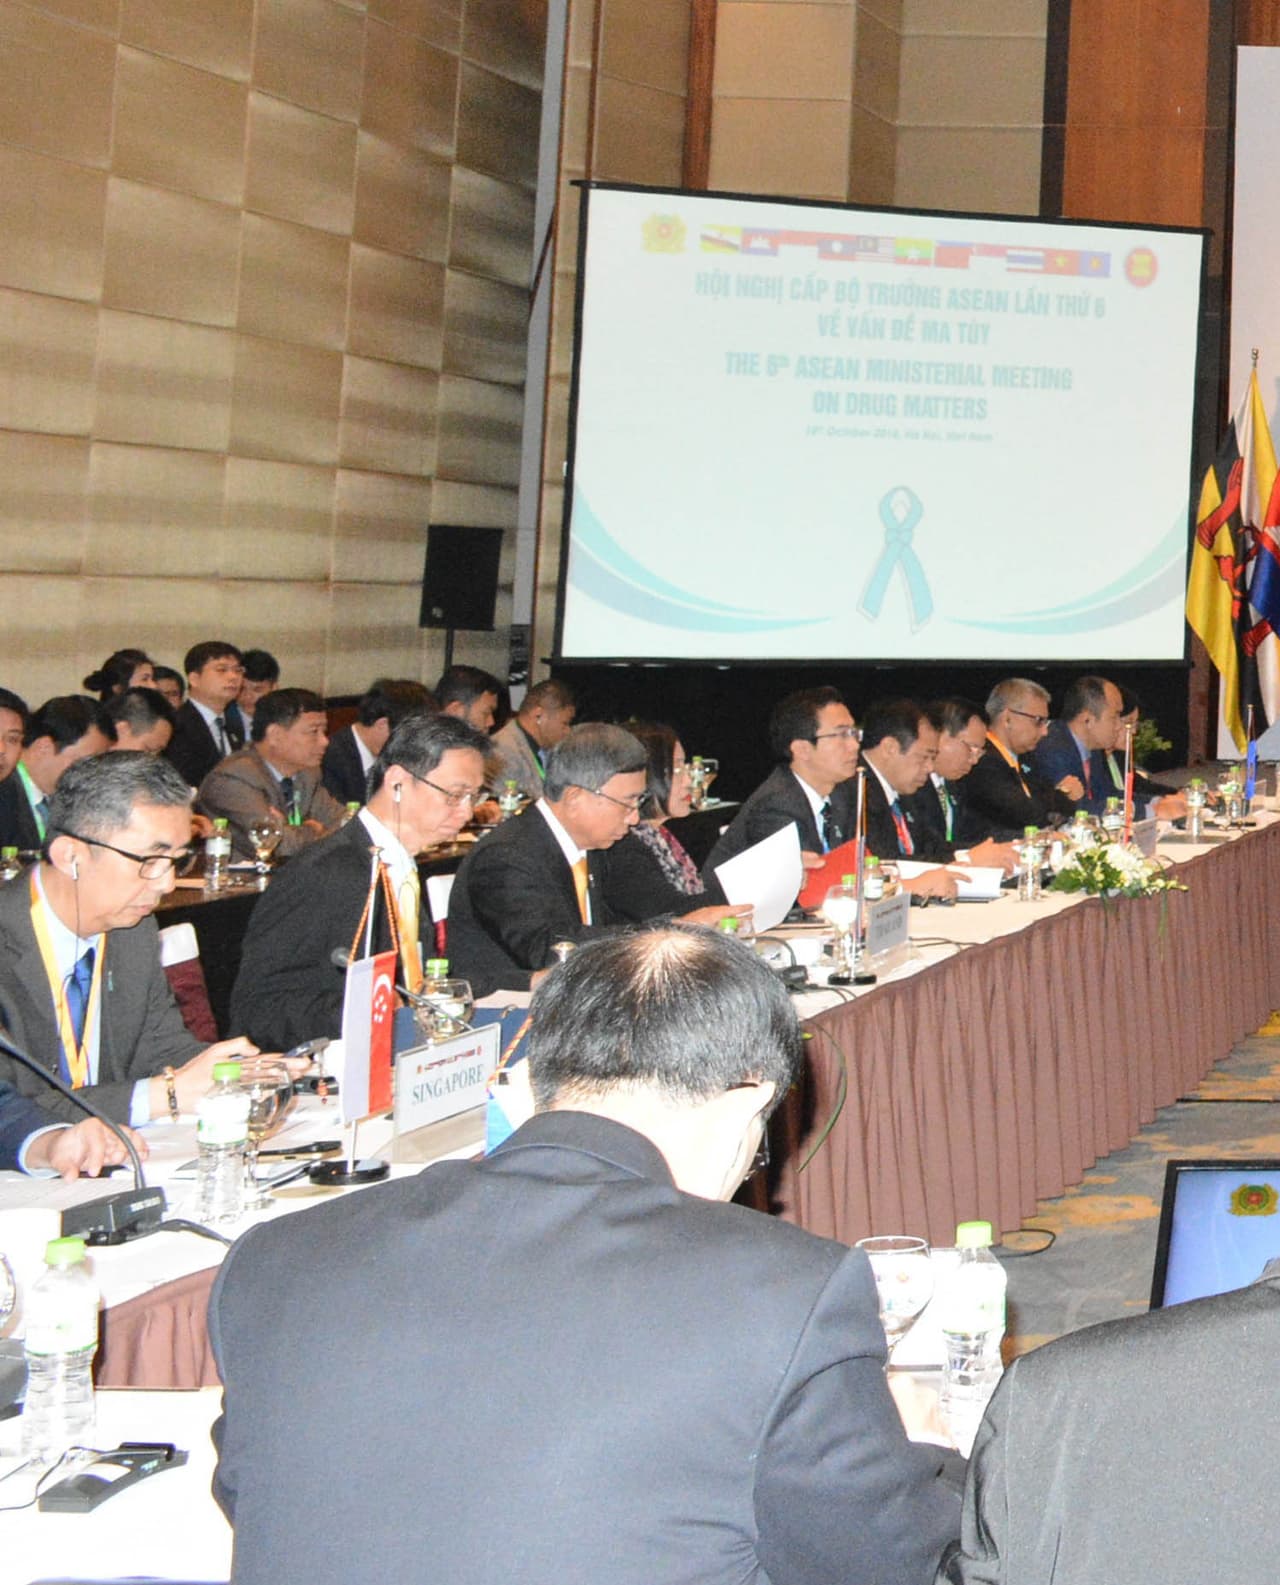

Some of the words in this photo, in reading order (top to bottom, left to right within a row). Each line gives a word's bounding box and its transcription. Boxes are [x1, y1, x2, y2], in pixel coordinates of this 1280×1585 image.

[947, 287, 1010, 314] ASEAN
[921, 319, 952, 344] MA
[725, 351, 761, 376] THE
[795, 354, 861, 380] ASEAN
[866, 357, 986, 387] MINISTERIAL
[991, 363, 1074, 391] MEETING
[813, 389, 840, 415] ON
[846, 391, 897, 417] DRUG
[903, 393, 988, 420] MATTERS
[411, 1064, 485, 1105] SINGAPORE
